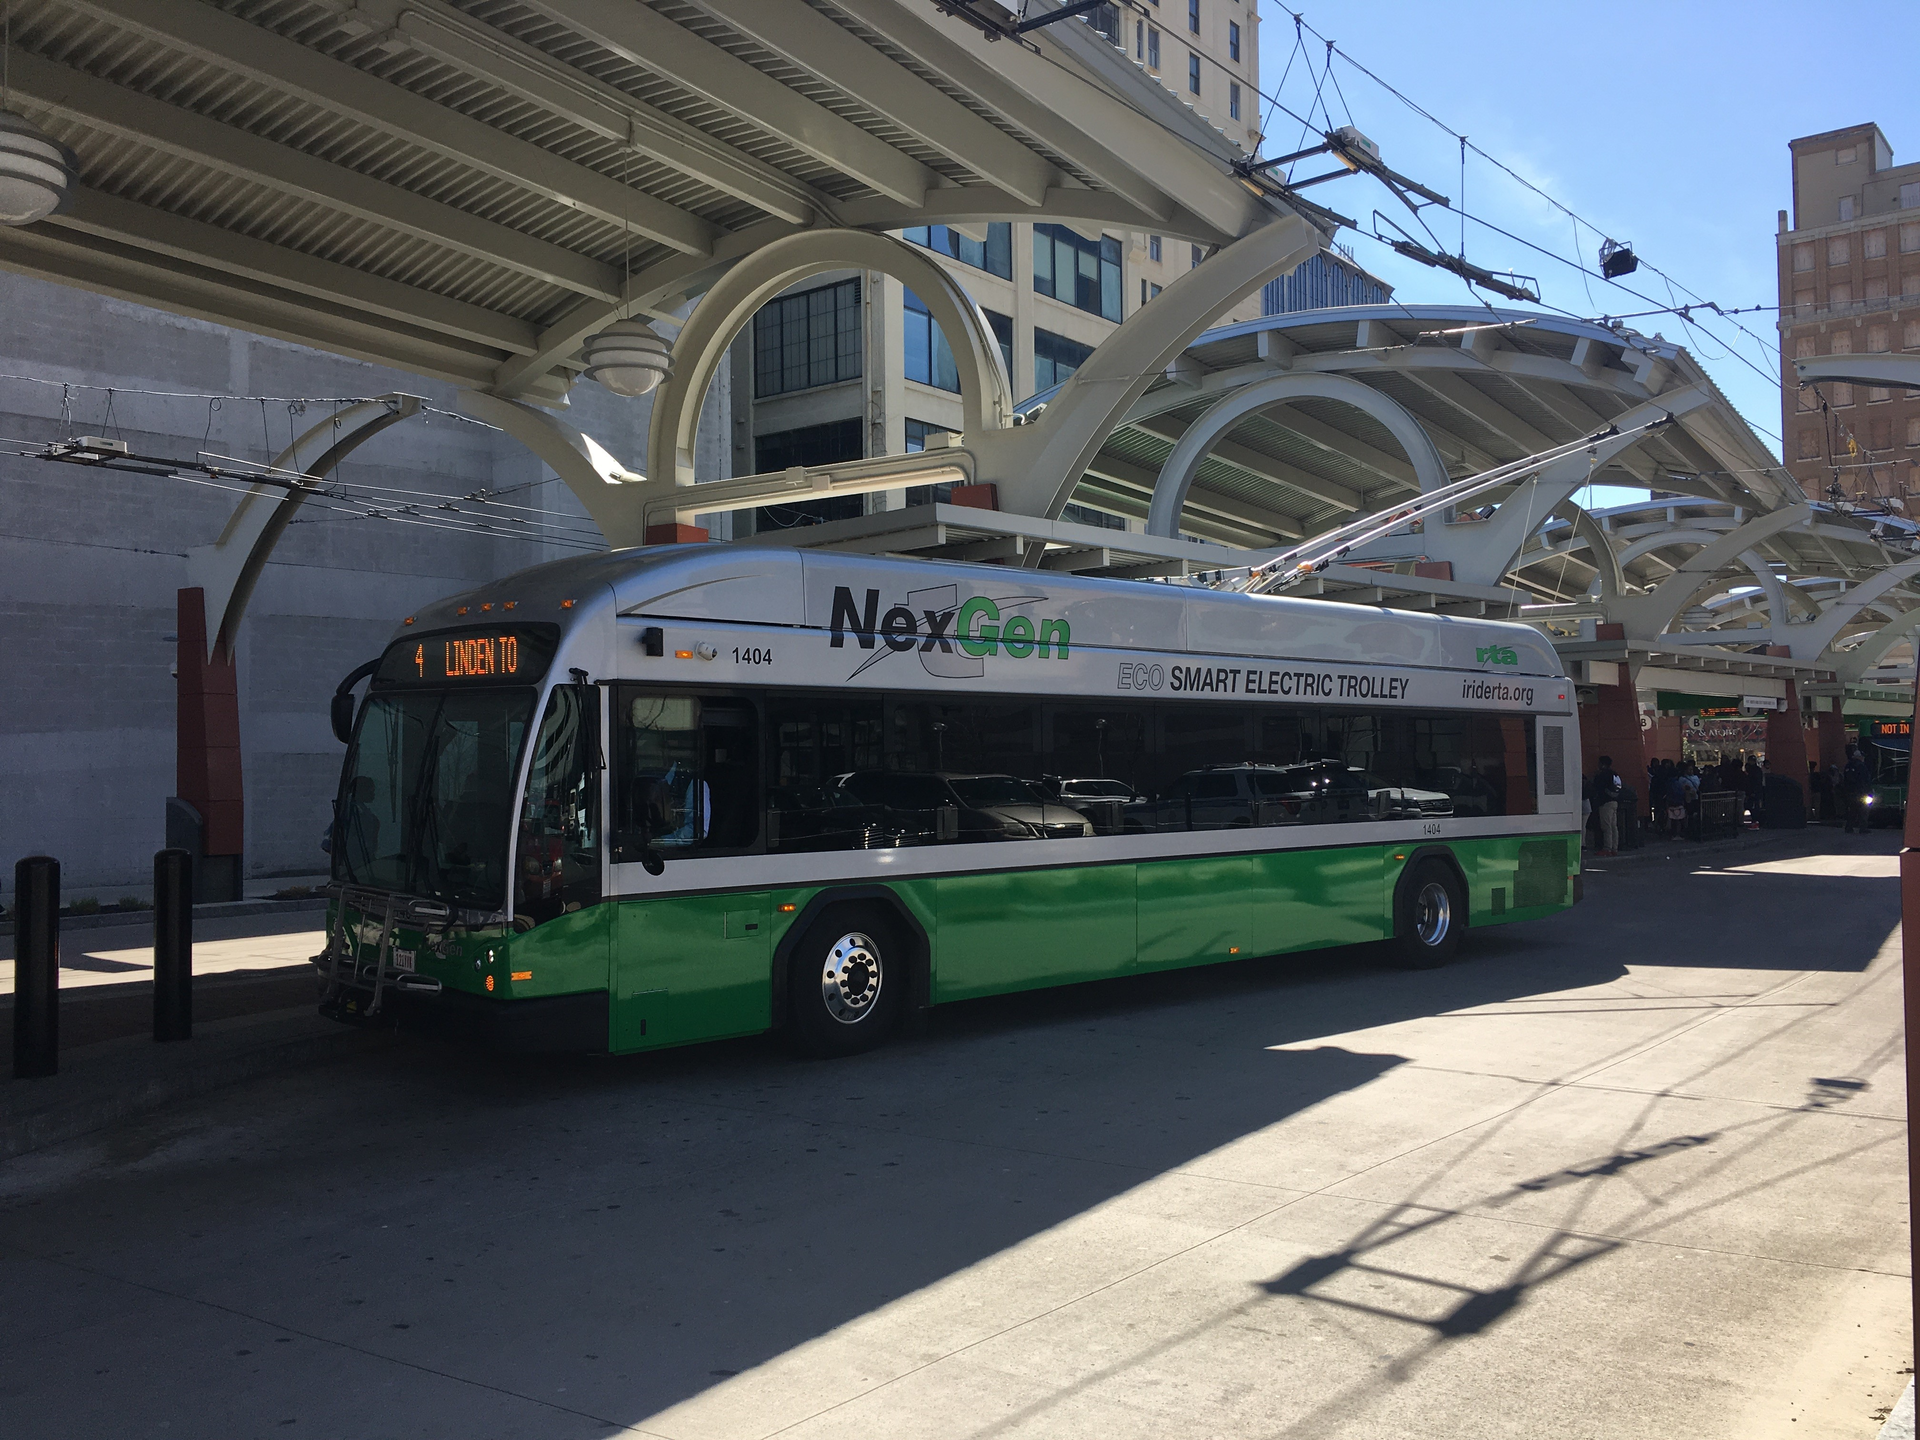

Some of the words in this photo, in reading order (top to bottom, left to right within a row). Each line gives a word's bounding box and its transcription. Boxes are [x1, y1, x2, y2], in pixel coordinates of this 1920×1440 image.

[830, 586, 1071, 660] NexGen
[415, 643, 424, 678] 4
[446, 638, 495, 676] LINDEN
[499, 636, 518, 674] TO
[732, 646, 773, 666] 1404
[1473, 644, 1519, 667] rta
[1117, 662, 1165, 691] ECO
[1170, 665, 1241, 693] SMART
[1244, 669, 1333, 697] ELECTRIC
[1337, 674, 1410, 700] TROLLEY
[1462, 679, 1534, 706] iriderta.org
[1693, 718, 1700, 727] B
[1881, 723, 1897, 734] NOT
[1899, 723, 1910, 734] IN
[1423, 824, 1441, 837] 1404
